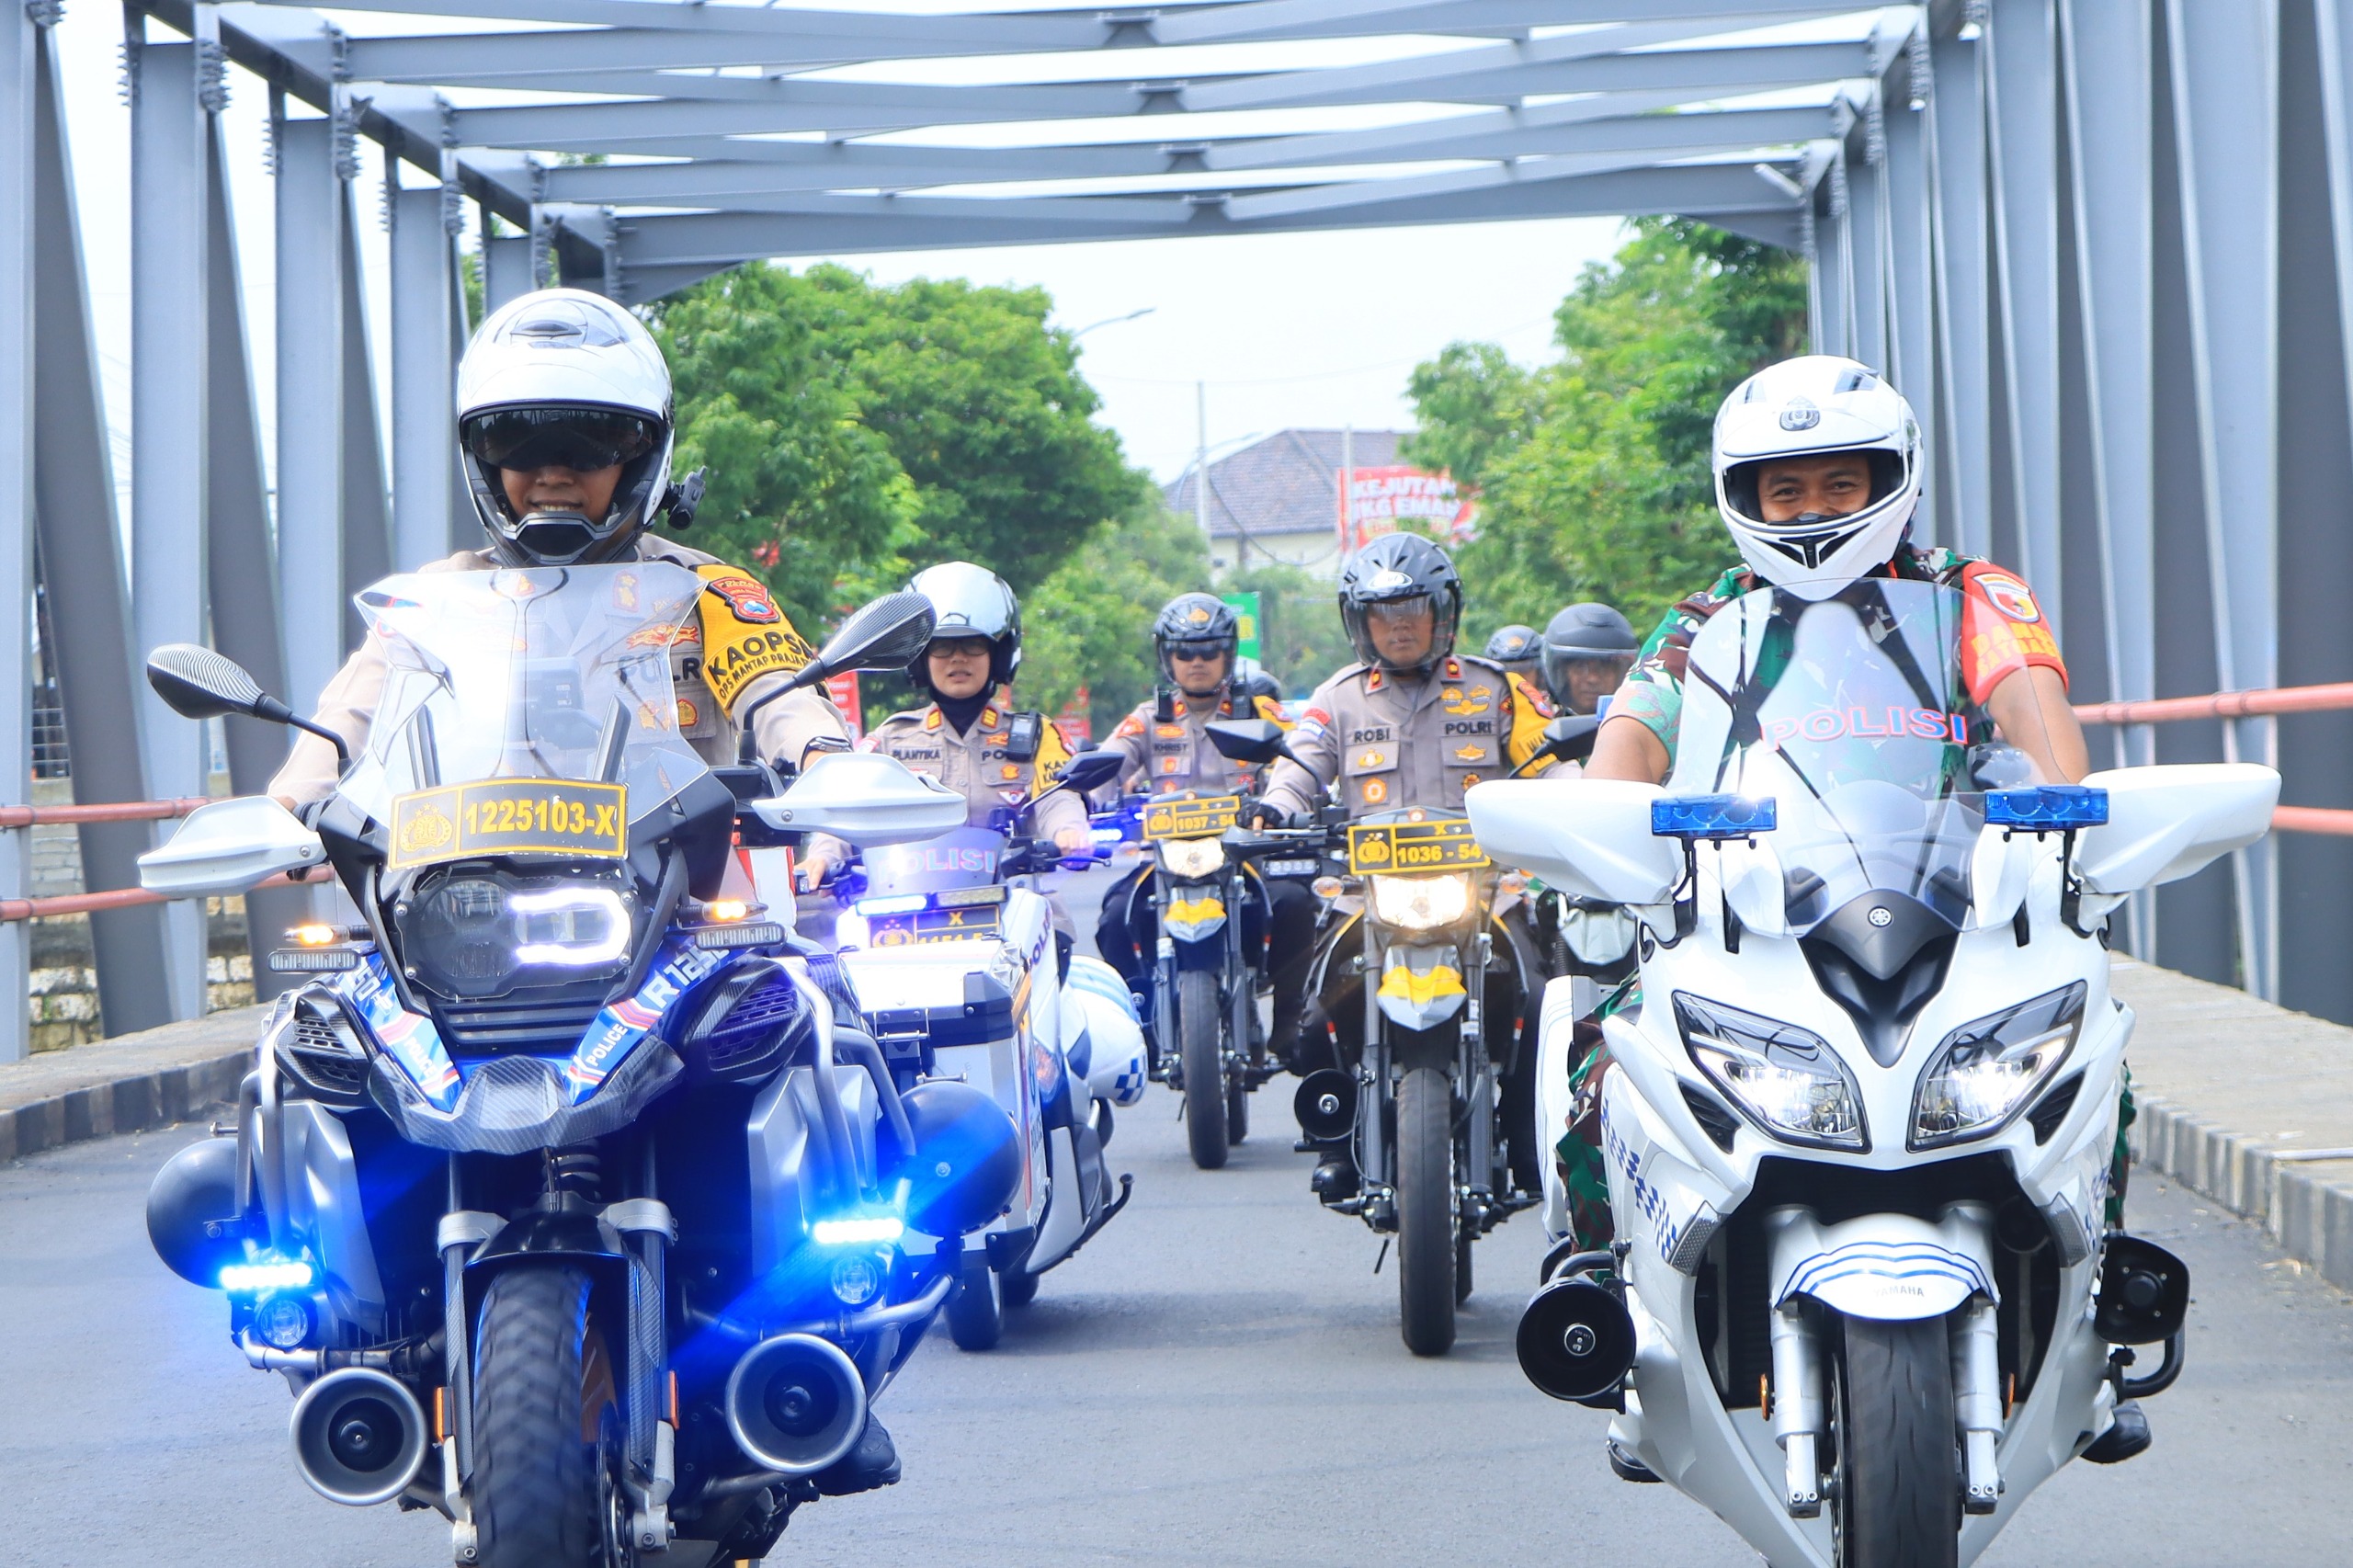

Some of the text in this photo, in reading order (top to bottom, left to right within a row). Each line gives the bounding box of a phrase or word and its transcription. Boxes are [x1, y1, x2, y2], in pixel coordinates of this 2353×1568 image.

[719, 676, 734, 699] OPS
[734, 655, 769, 683] MANTAP
[1354, 728, 1390, 743] ROBI
[1445, 721, 1492, 734] POLRI
[1760, 706, 1969, 751] POLISI
[892, 748, 941, 761] PLANTIKA
[465, 799, 616, 836] 1225103-X
[1435, 824, 1448, 835] X
[1397, 845, 1444, 864] 1036
[1458, 843, 1483, 860] 54
[949, 911, 964, 926] X
[642, 972, 681, 1009] R
[585, 1022, 629, 1067] POLICE
[404, 1036, 440, 1077] POLICE
[1873, 1285, 1925, 1298] YAMAHA
